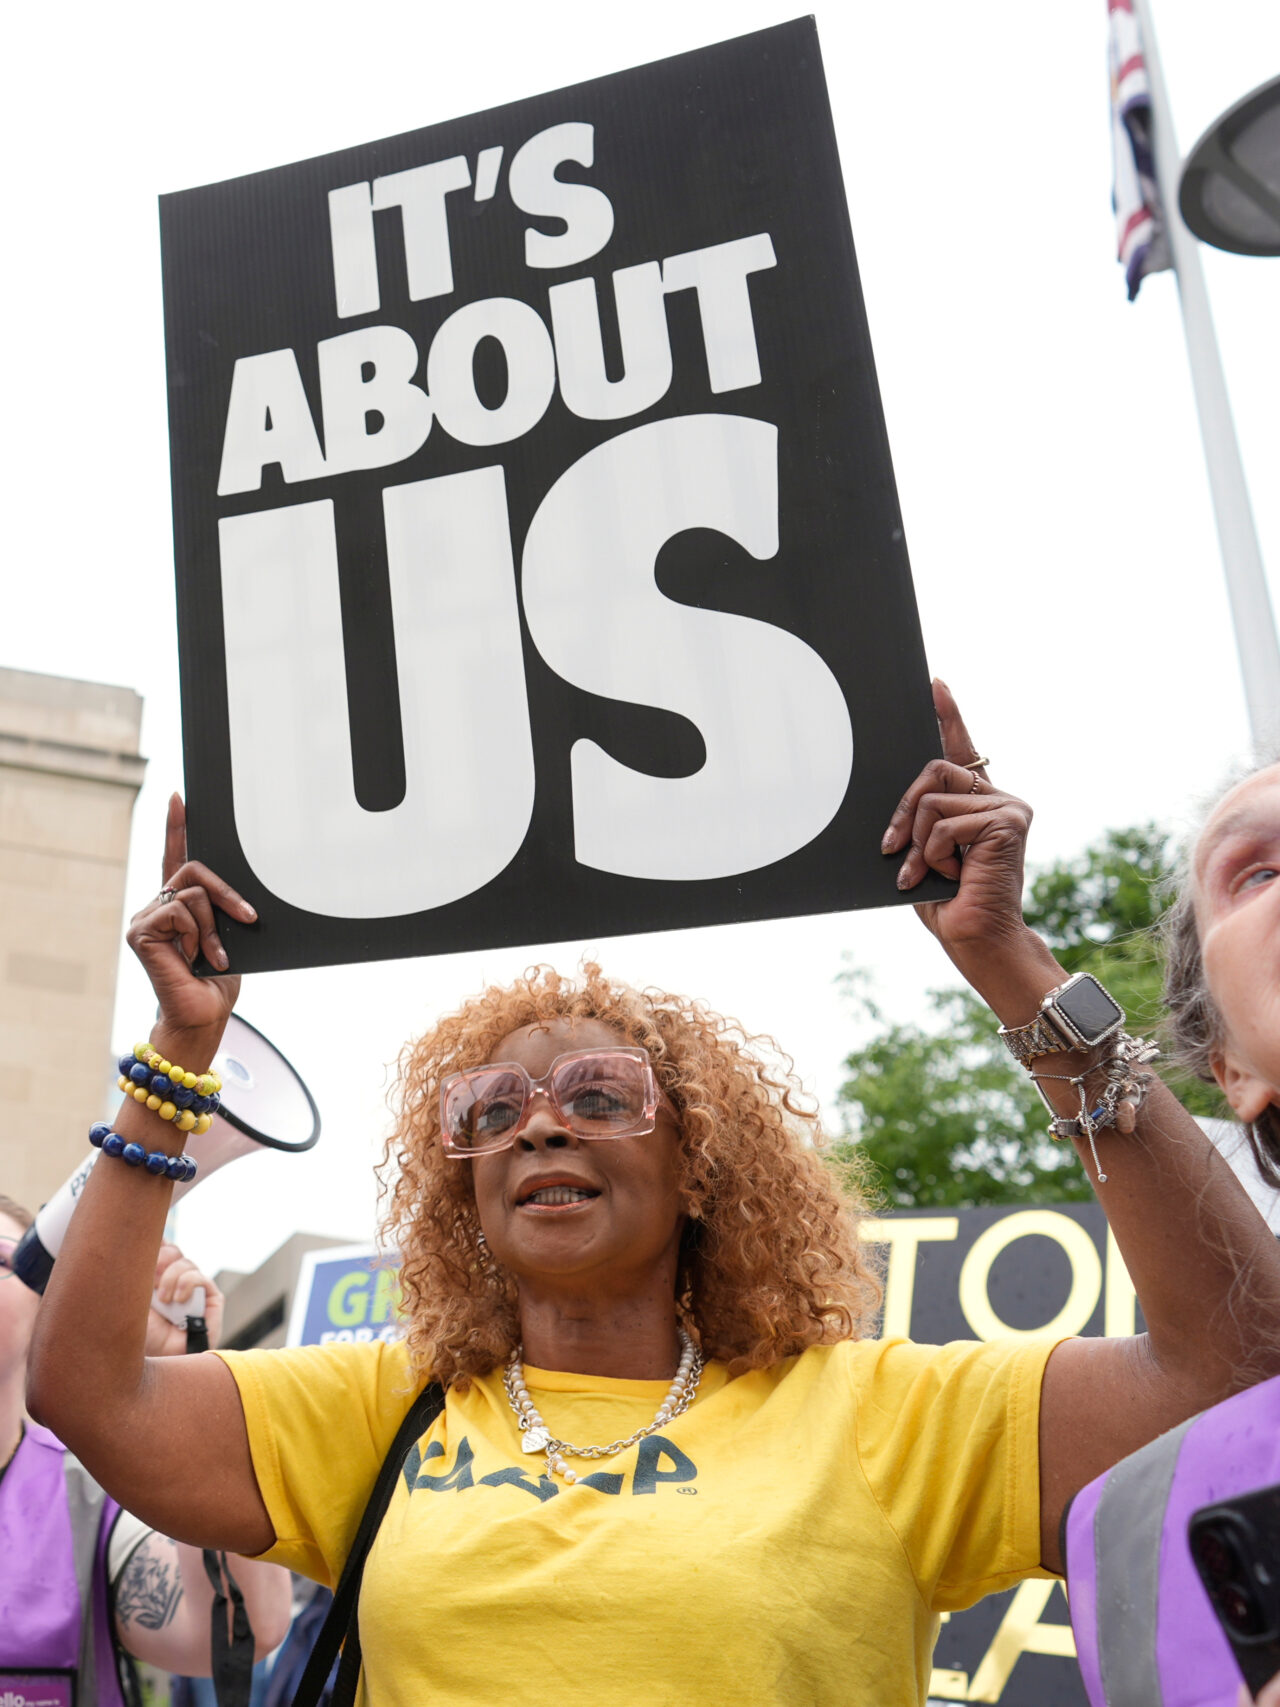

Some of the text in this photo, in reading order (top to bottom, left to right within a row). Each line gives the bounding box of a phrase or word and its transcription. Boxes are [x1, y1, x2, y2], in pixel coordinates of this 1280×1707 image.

[328, 122, 615, 319] IT'S
[217, 233, 778, 497] ABOUT
[217, 414, 854, 919] US
